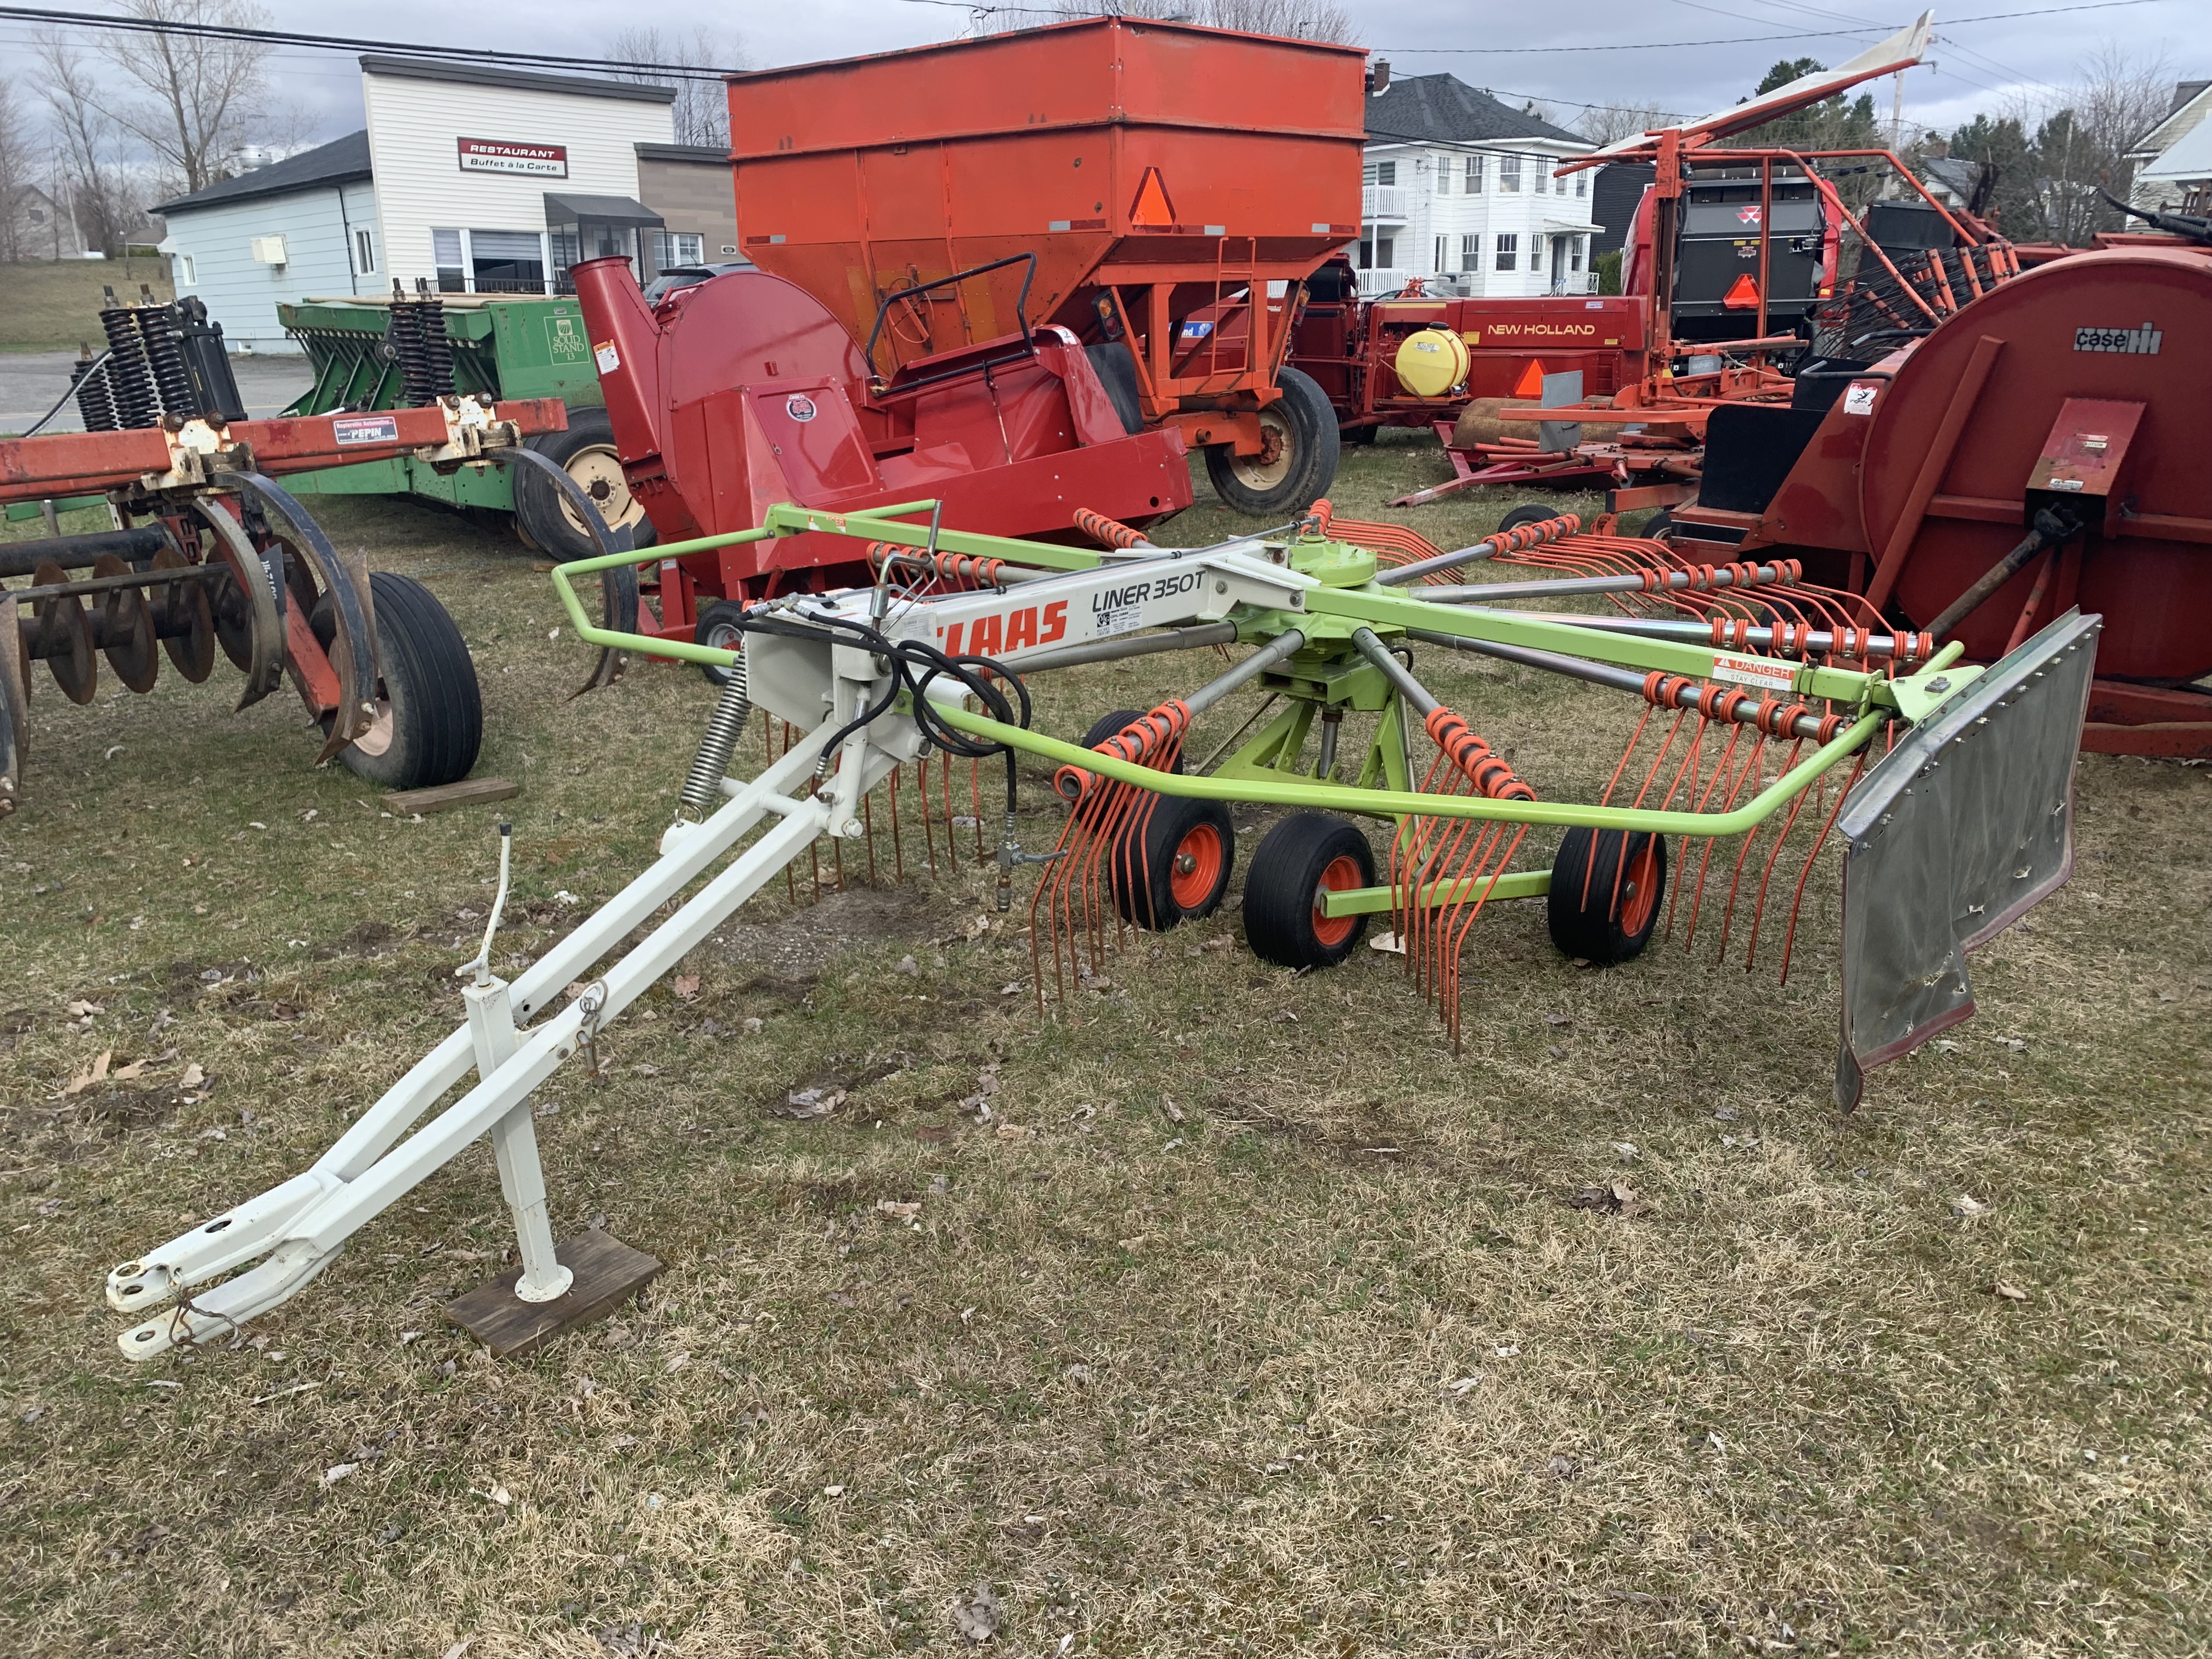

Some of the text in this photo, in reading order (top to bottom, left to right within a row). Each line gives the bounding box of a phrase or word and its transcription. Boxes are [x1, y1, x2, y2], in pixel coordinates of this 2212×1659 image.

[470, 144, 555, 158] RESTAURANT
[471, 159, 504, 167] Buffet
[527, 163, 557, 171] Carte
[1488, 324, 1595, 335] NEW HOLLAND
[553, 335, 580, 346] SOLID
[552, 343, 584, 353] STAND
[351, 427, 382, 438] PEPIN
[1092, 570, 1206, 612] LINER 350T
[1735, 659, 1790, 679] DANGER
[1730, 674, 1773, 687] STAY CLEAR
